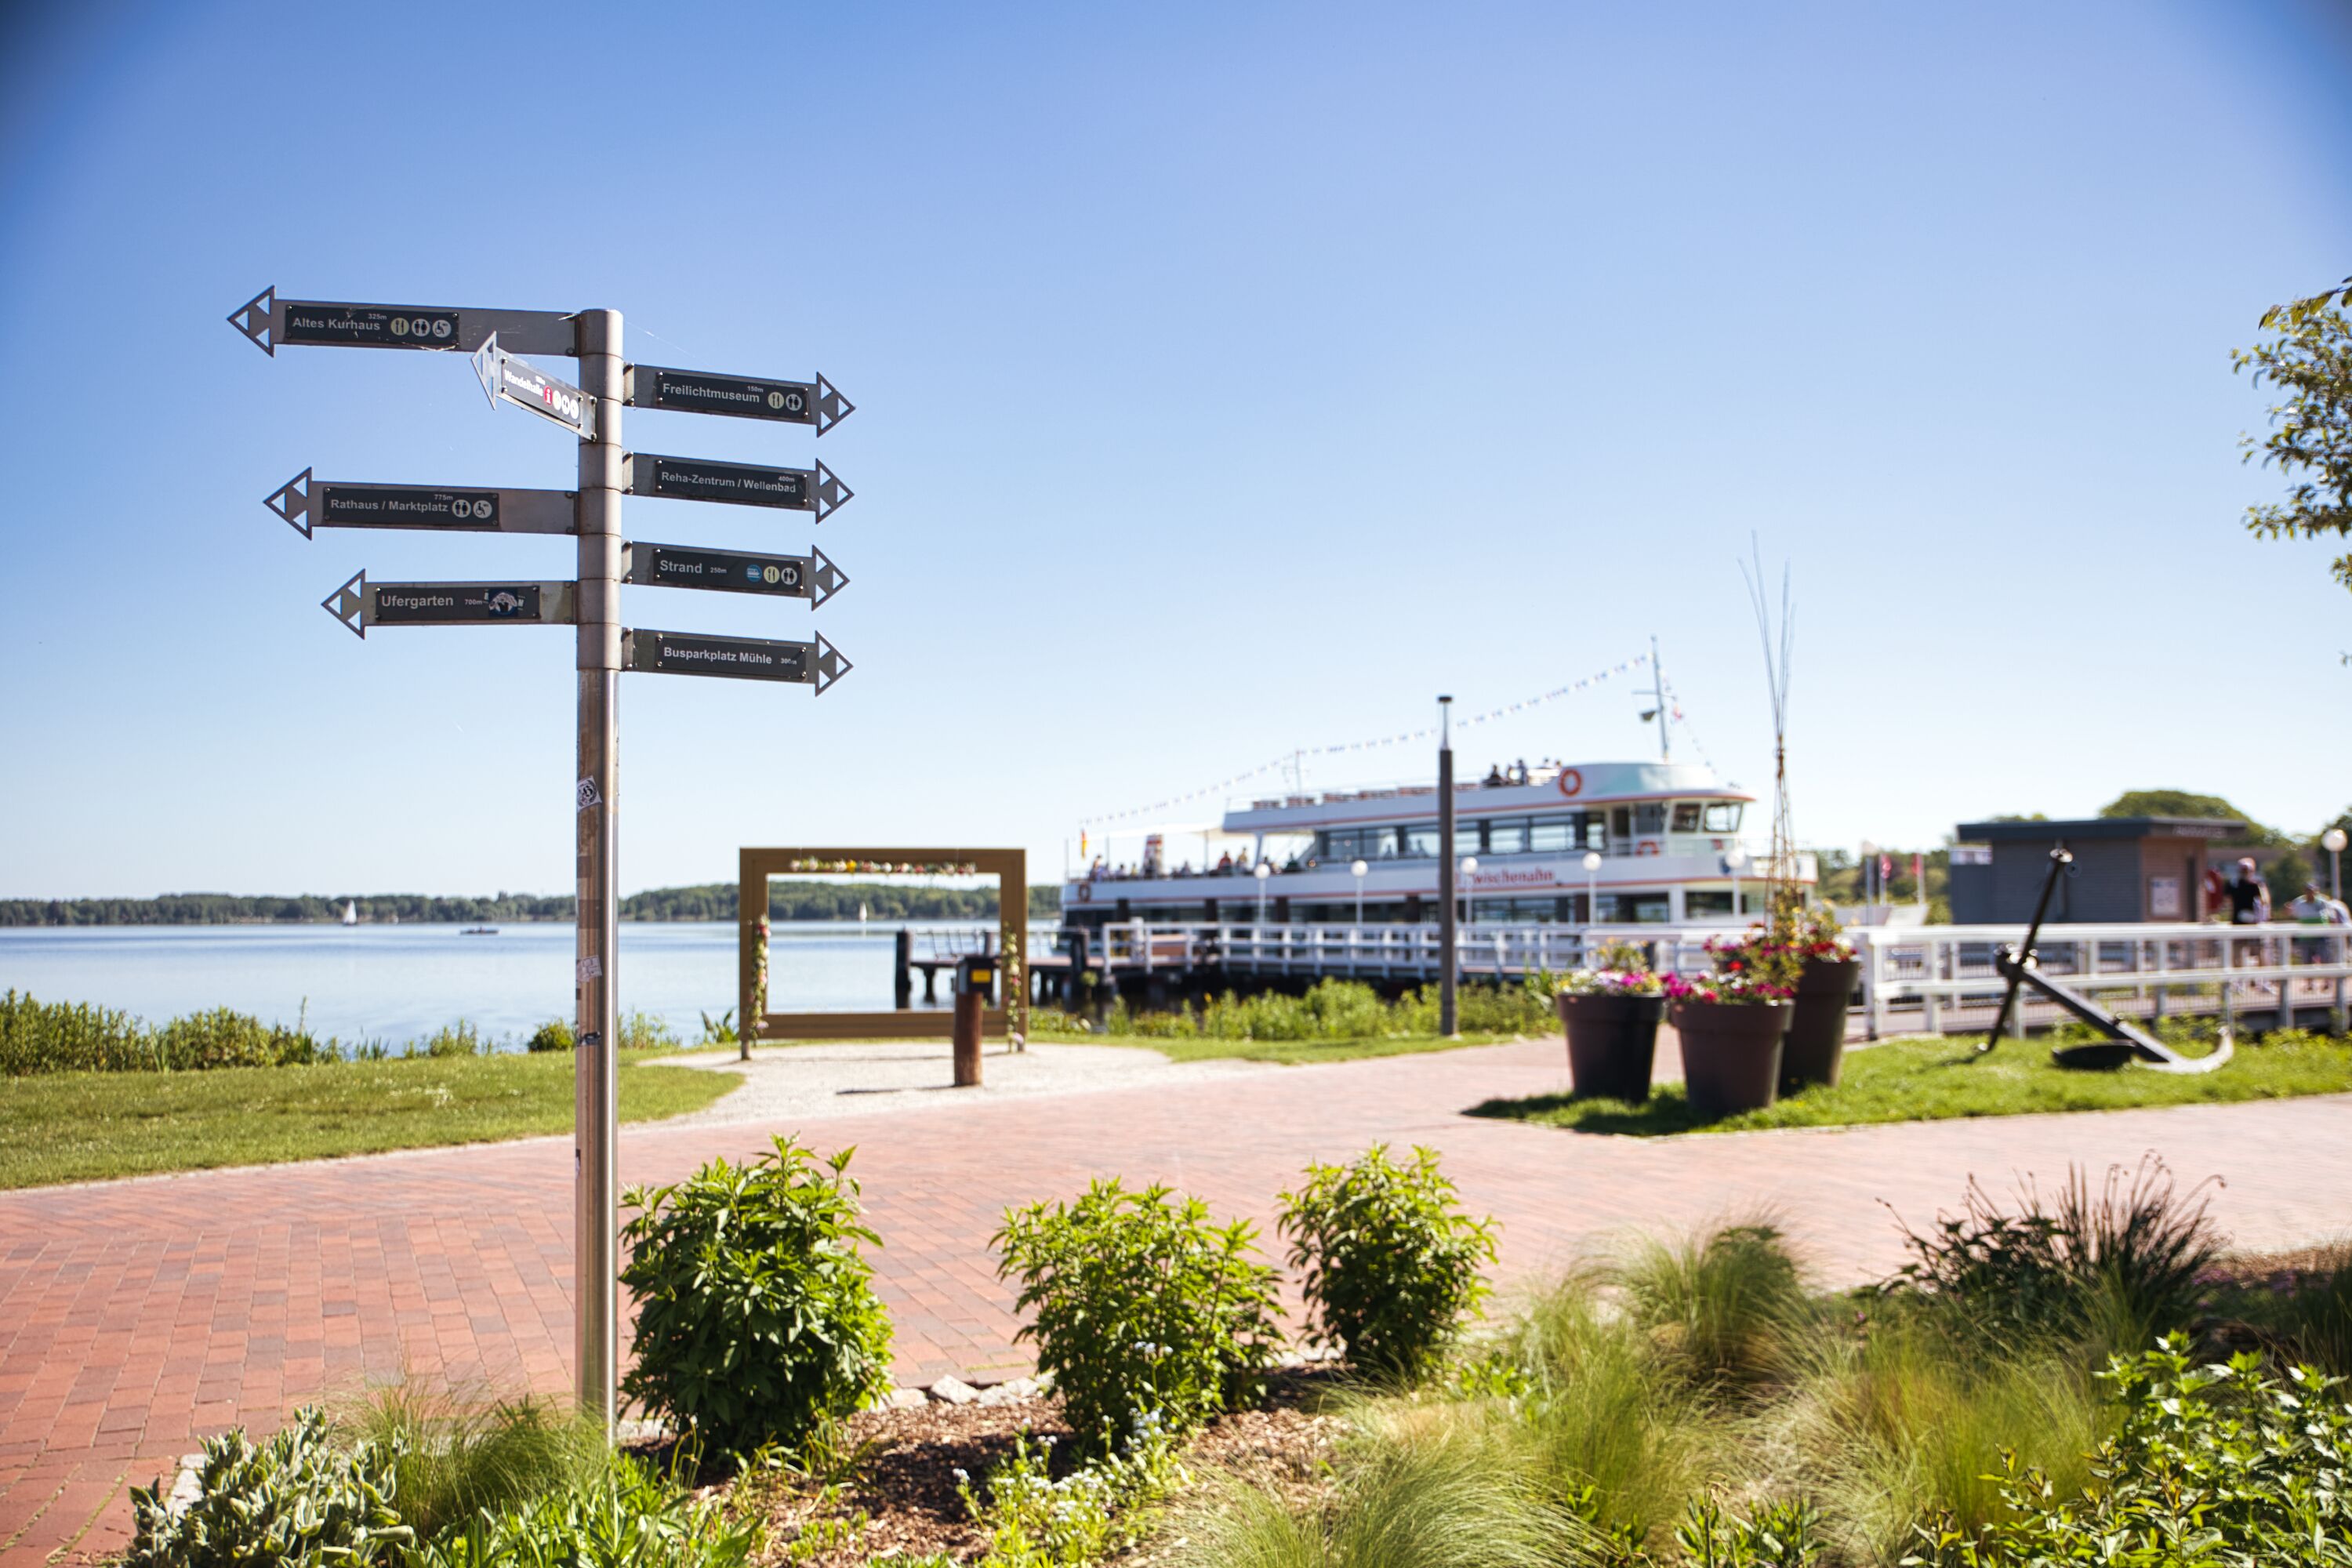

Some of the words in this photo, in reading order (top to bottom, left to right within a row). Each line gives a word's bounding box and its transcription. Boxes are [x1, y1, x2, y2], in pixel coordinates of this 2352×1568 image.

[292, 317, 325, 328] Altes
[328, 318, 381, 331] Kurhaus
[504, 369, 543, 397] Wandelhalle
[662, 383, 760, 403] Freilichtmuseum
[661, 472, 735, 488] Reha-Zentrum
[743, 479, 797, 493] Wellenbad
[330, 499, 379, 510] Rathaus
[388, 499, 448, 514] Marktplatz
[659, 559, 702, 575] Strand
[381, 595, 454, 609] Ufergarten
[663, 646, 737, 663] Busparkplatz
[739, 652, 772, 666] Mühle
